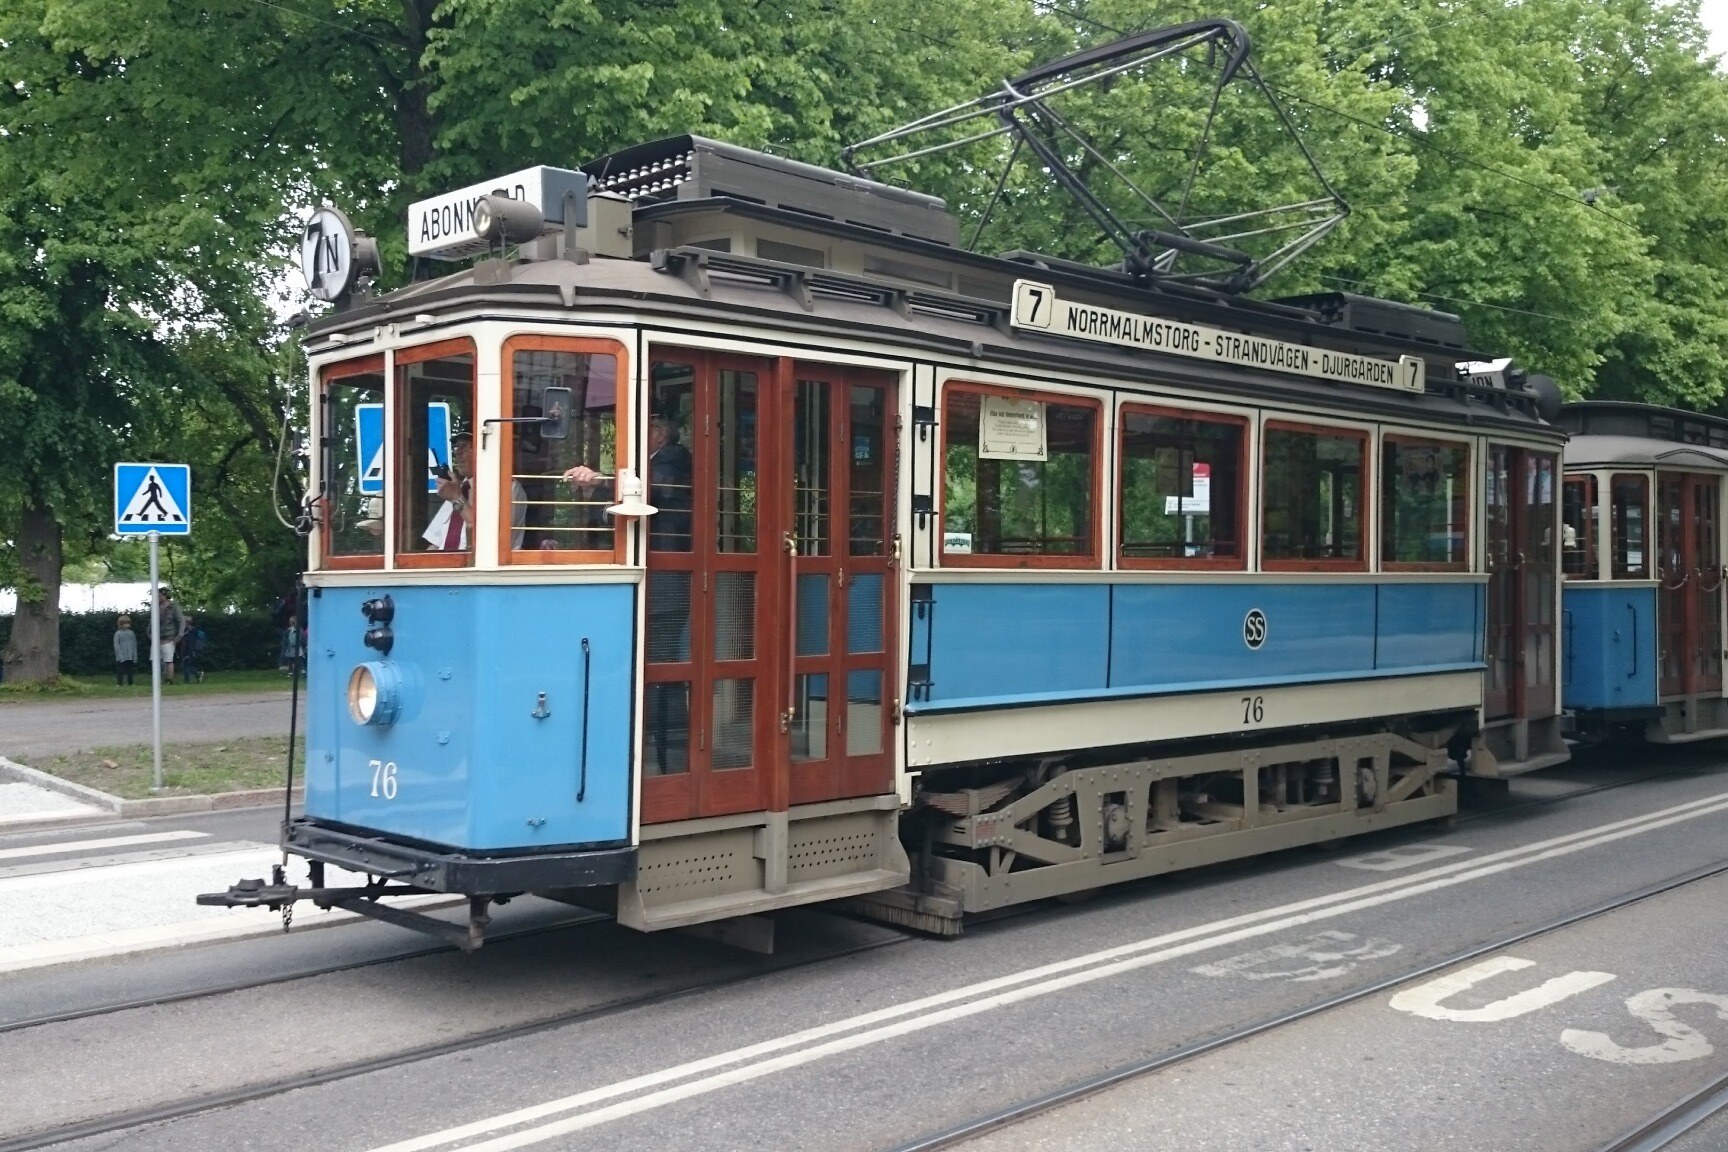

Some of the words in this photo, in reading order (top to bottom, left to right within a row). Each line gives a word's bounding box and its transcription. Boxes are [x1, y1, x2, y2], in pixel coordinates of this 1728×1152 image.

[1029, 289, 1043, 322] 7
[1067, 306, 1199, 352] NORRMALMSTORG
[1215, 335, 1309, 371] STRANDVÄGEN
[1322, 353, 1393, 385] DJURGÅRDEN
[1409, 362, 1418, 387] 7
[1247, 616, 1263, 640] SS
[1241, 696, 1263, 724] 76
[369, 760, 397, 799] 76
